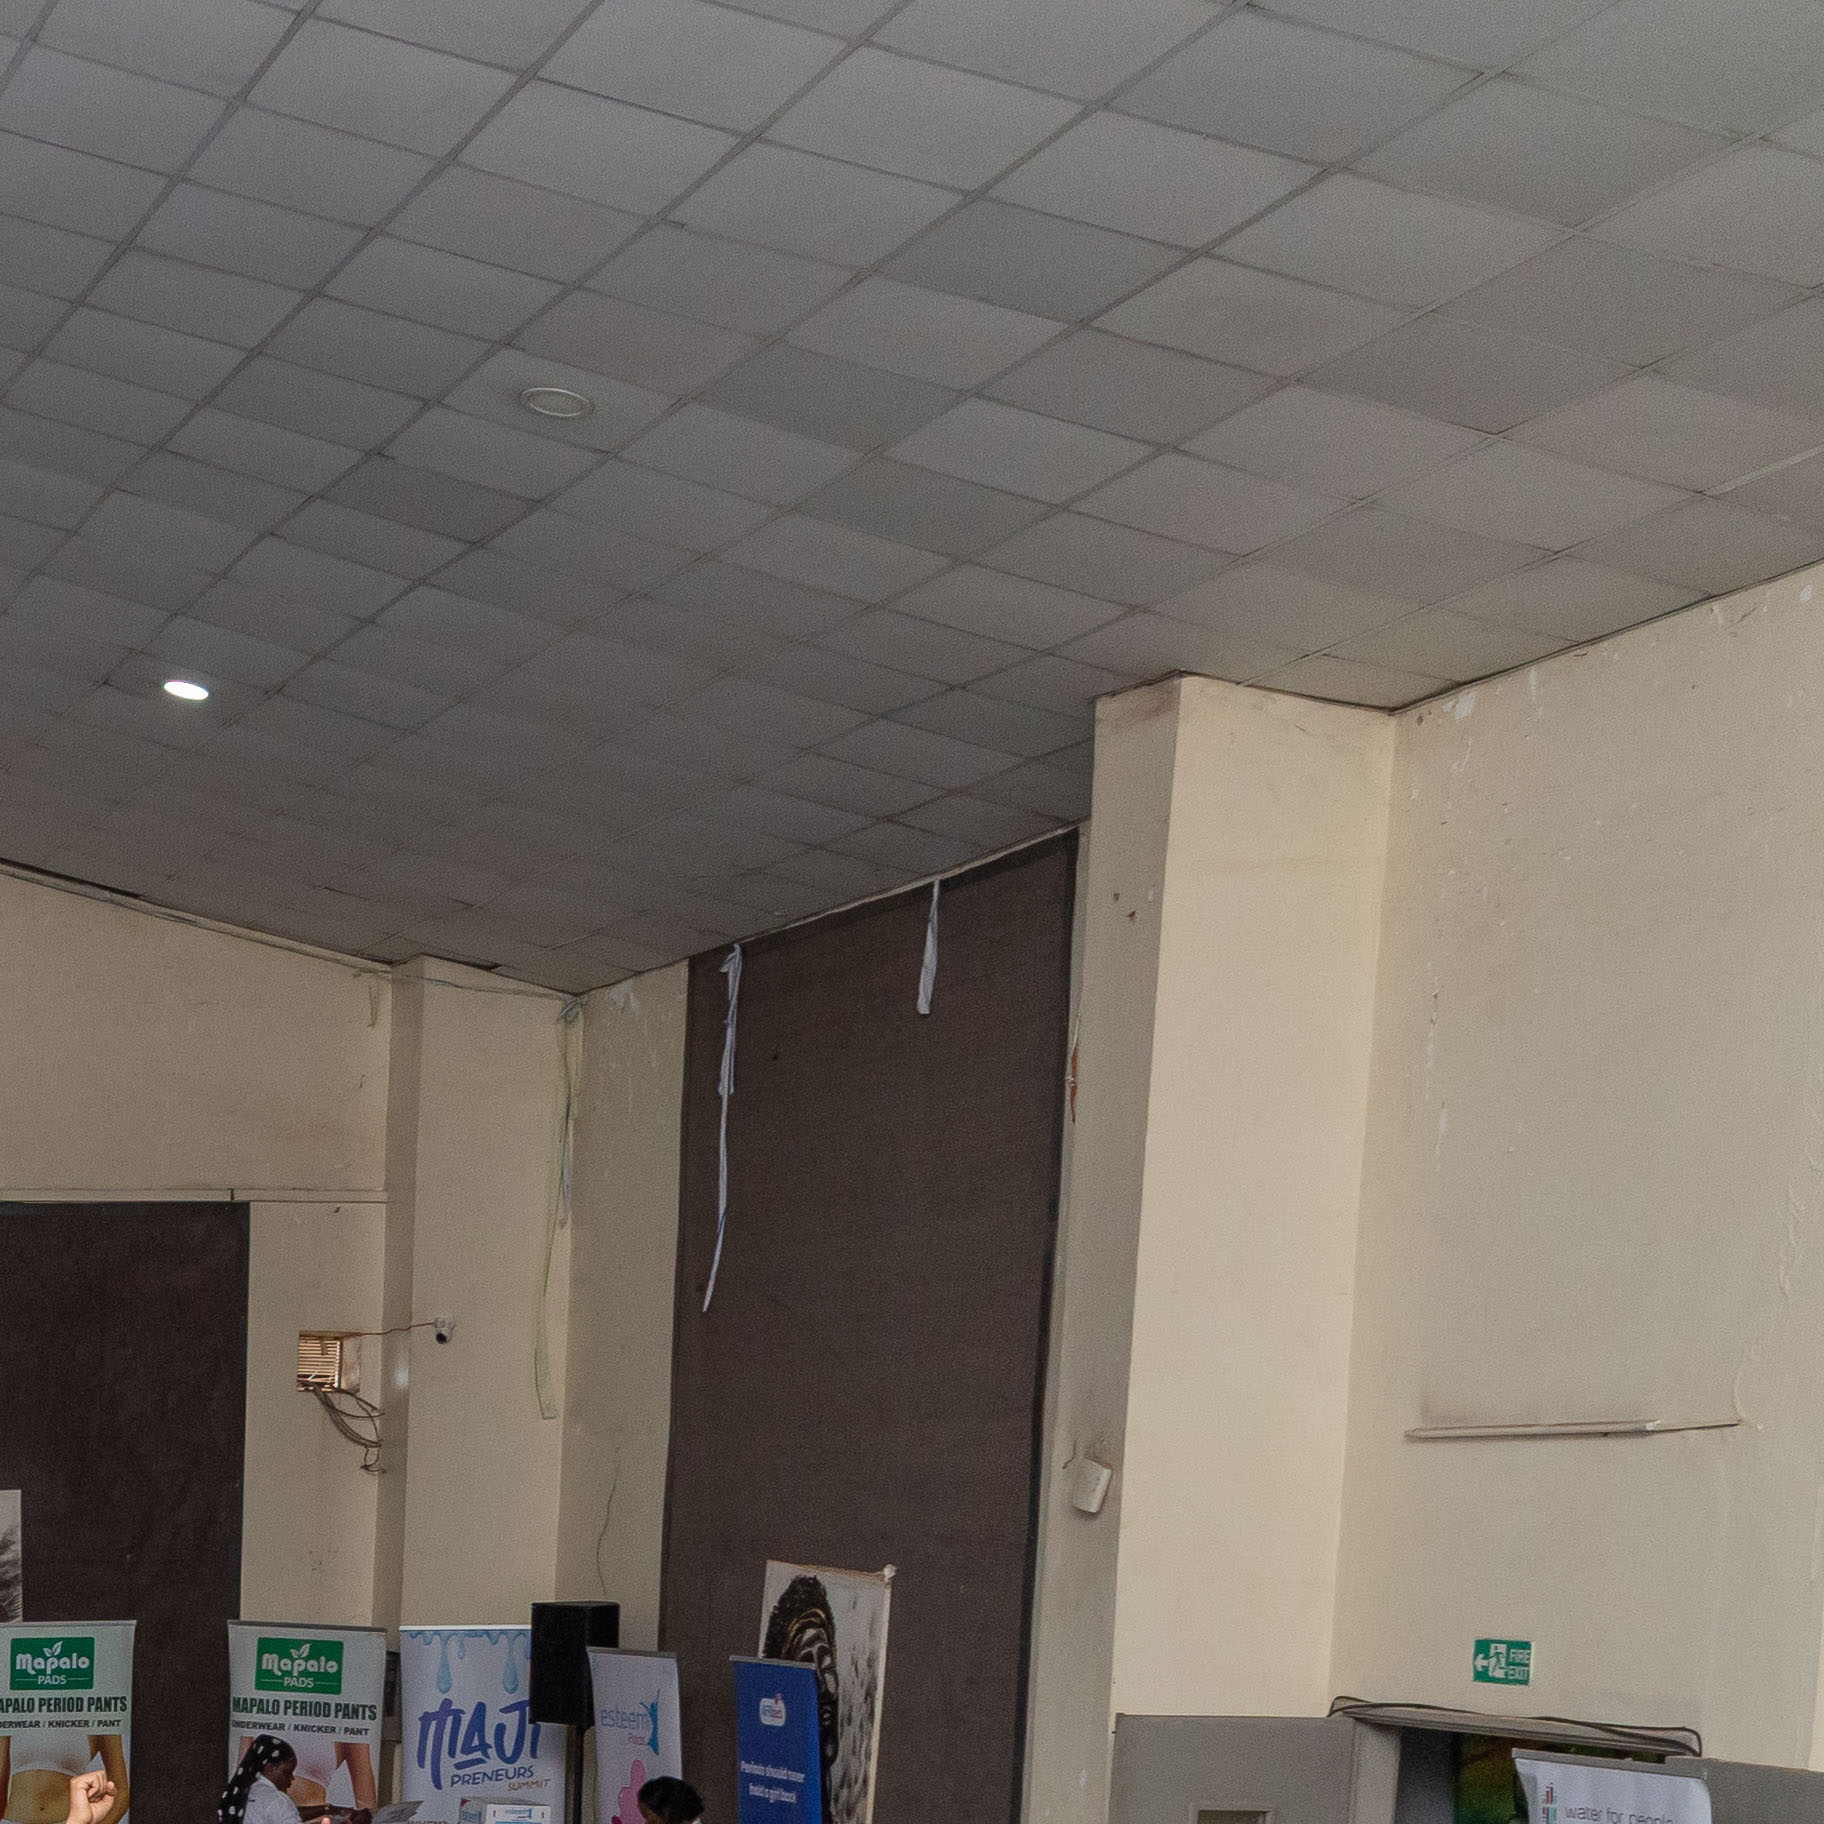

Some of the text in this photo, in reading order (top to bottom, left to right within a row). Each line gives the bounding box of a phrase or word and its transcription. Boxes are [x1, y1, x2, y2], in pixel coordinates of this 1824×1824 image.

[15, 1652, 90, 1675] Mapalo
[1510, 1648, 1530, 1663] FIRE
[261, 1653, 338, 1676] Mapalo
[37, 1674, 68, 1685] PADS
[1507, 1666, 1529, 1680] EXIT
[283, 1676, 314, 1688] PADS
[38, 1697, 84, 1713] PERIOD
[87, 1696, 128, 1713] PANTS
[232, 1697, 377, 1721] MAPALO PERIOD PANTS
[47, 1719, 90, 1728] KNICKER
[97, 1719, 122, 1728] PANT
[231, 1720, 370, 1736] UNDERWEAR KNICKER PANT
[450, 1765, 534, 1788] PRENEURS
[507, 1779, 551, 1792] SUMMIT
[1565, 1805, 1603, 1822] water
[1606, 1807, 1624, 1824] for
